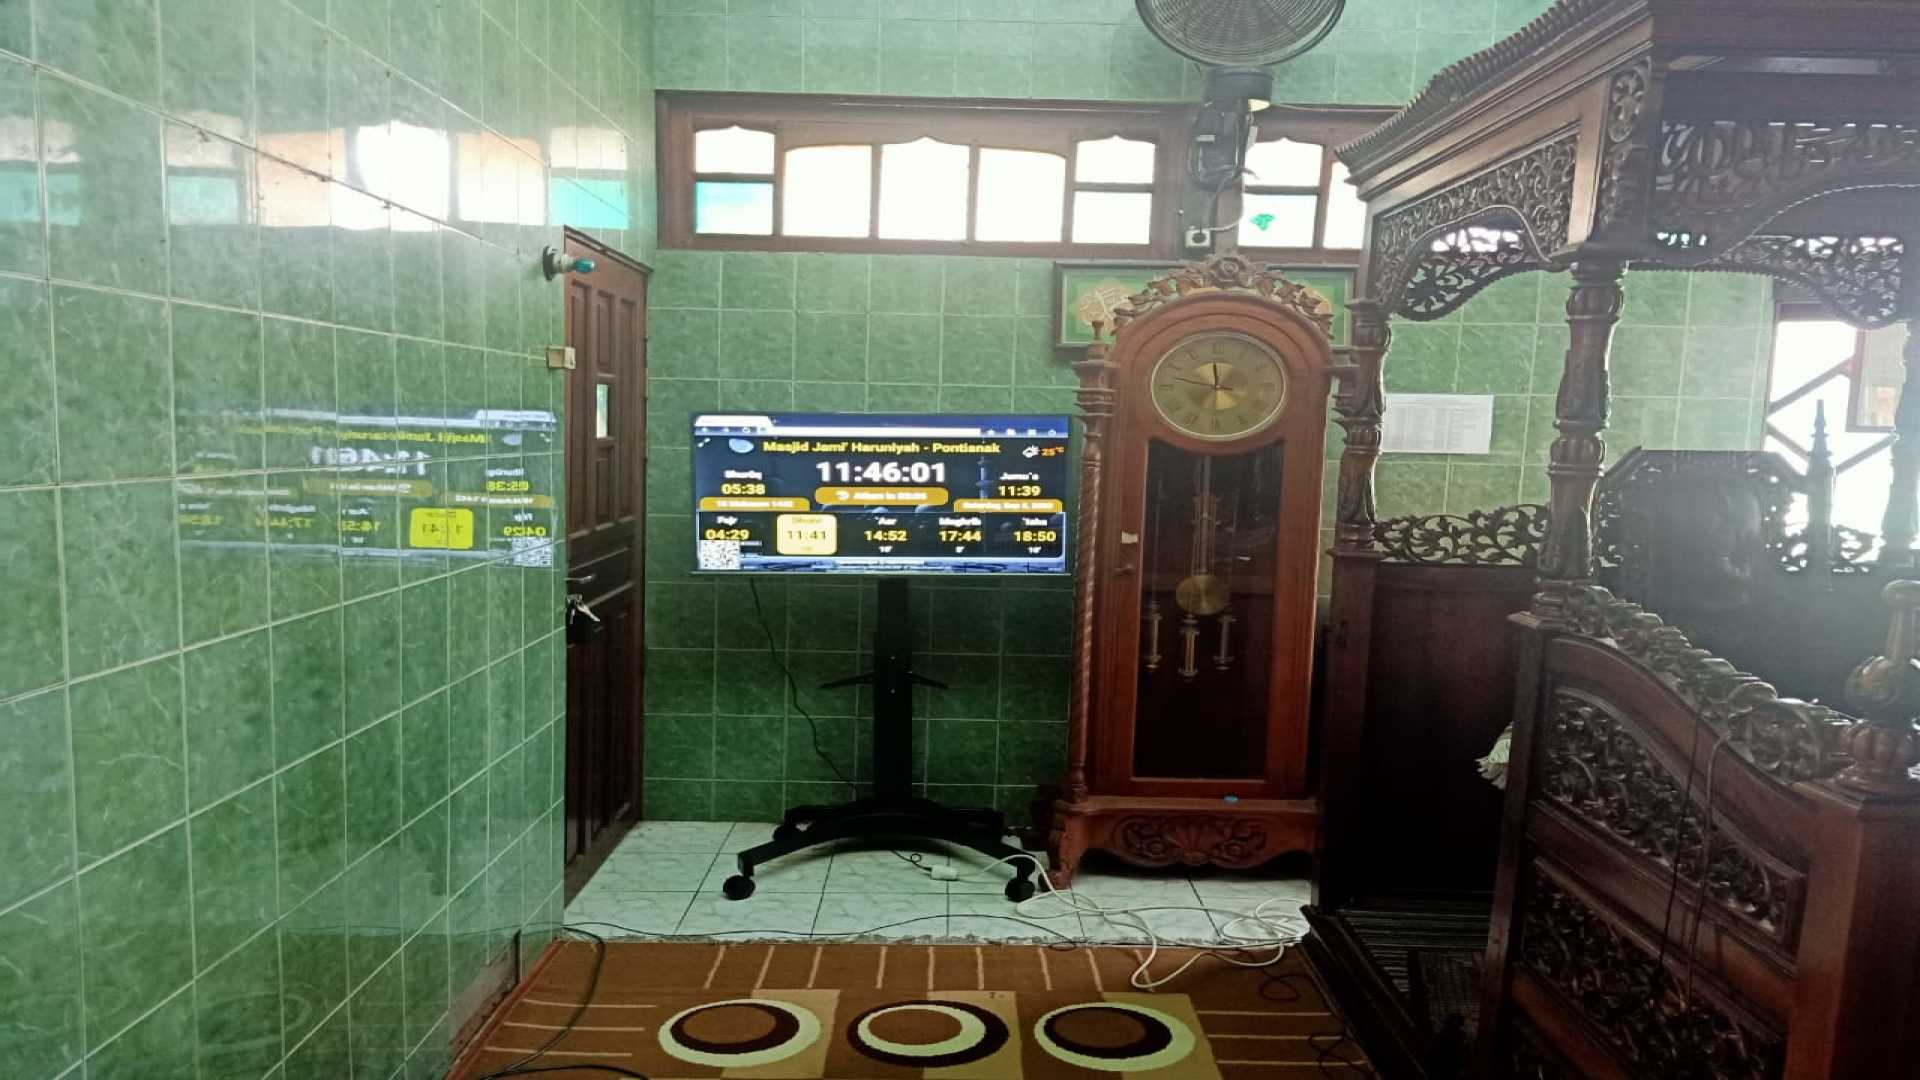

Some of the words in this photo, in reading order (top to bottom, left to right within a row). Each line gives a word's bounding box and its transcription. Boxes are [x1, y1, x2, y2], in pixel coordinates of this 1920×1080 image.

[762, 440, 809, 455] Masjid
[852, 441, 920, 455] Haruniyah
[932, 442, 1001, 454] Pontianak
[815, 461, 945, 482] 11:46:01
[720, 483, 766, 495] 05:38
[998, 485, 1041, 497] 11:39
[704, 529, 750, 540] 04:29
[786, 530, 826, 541] 11:41
[864, 530, 908, 541] 14:52
[939, 530, 982, 542] 17:44
[1013, 530, 1057, 542] 18:50
